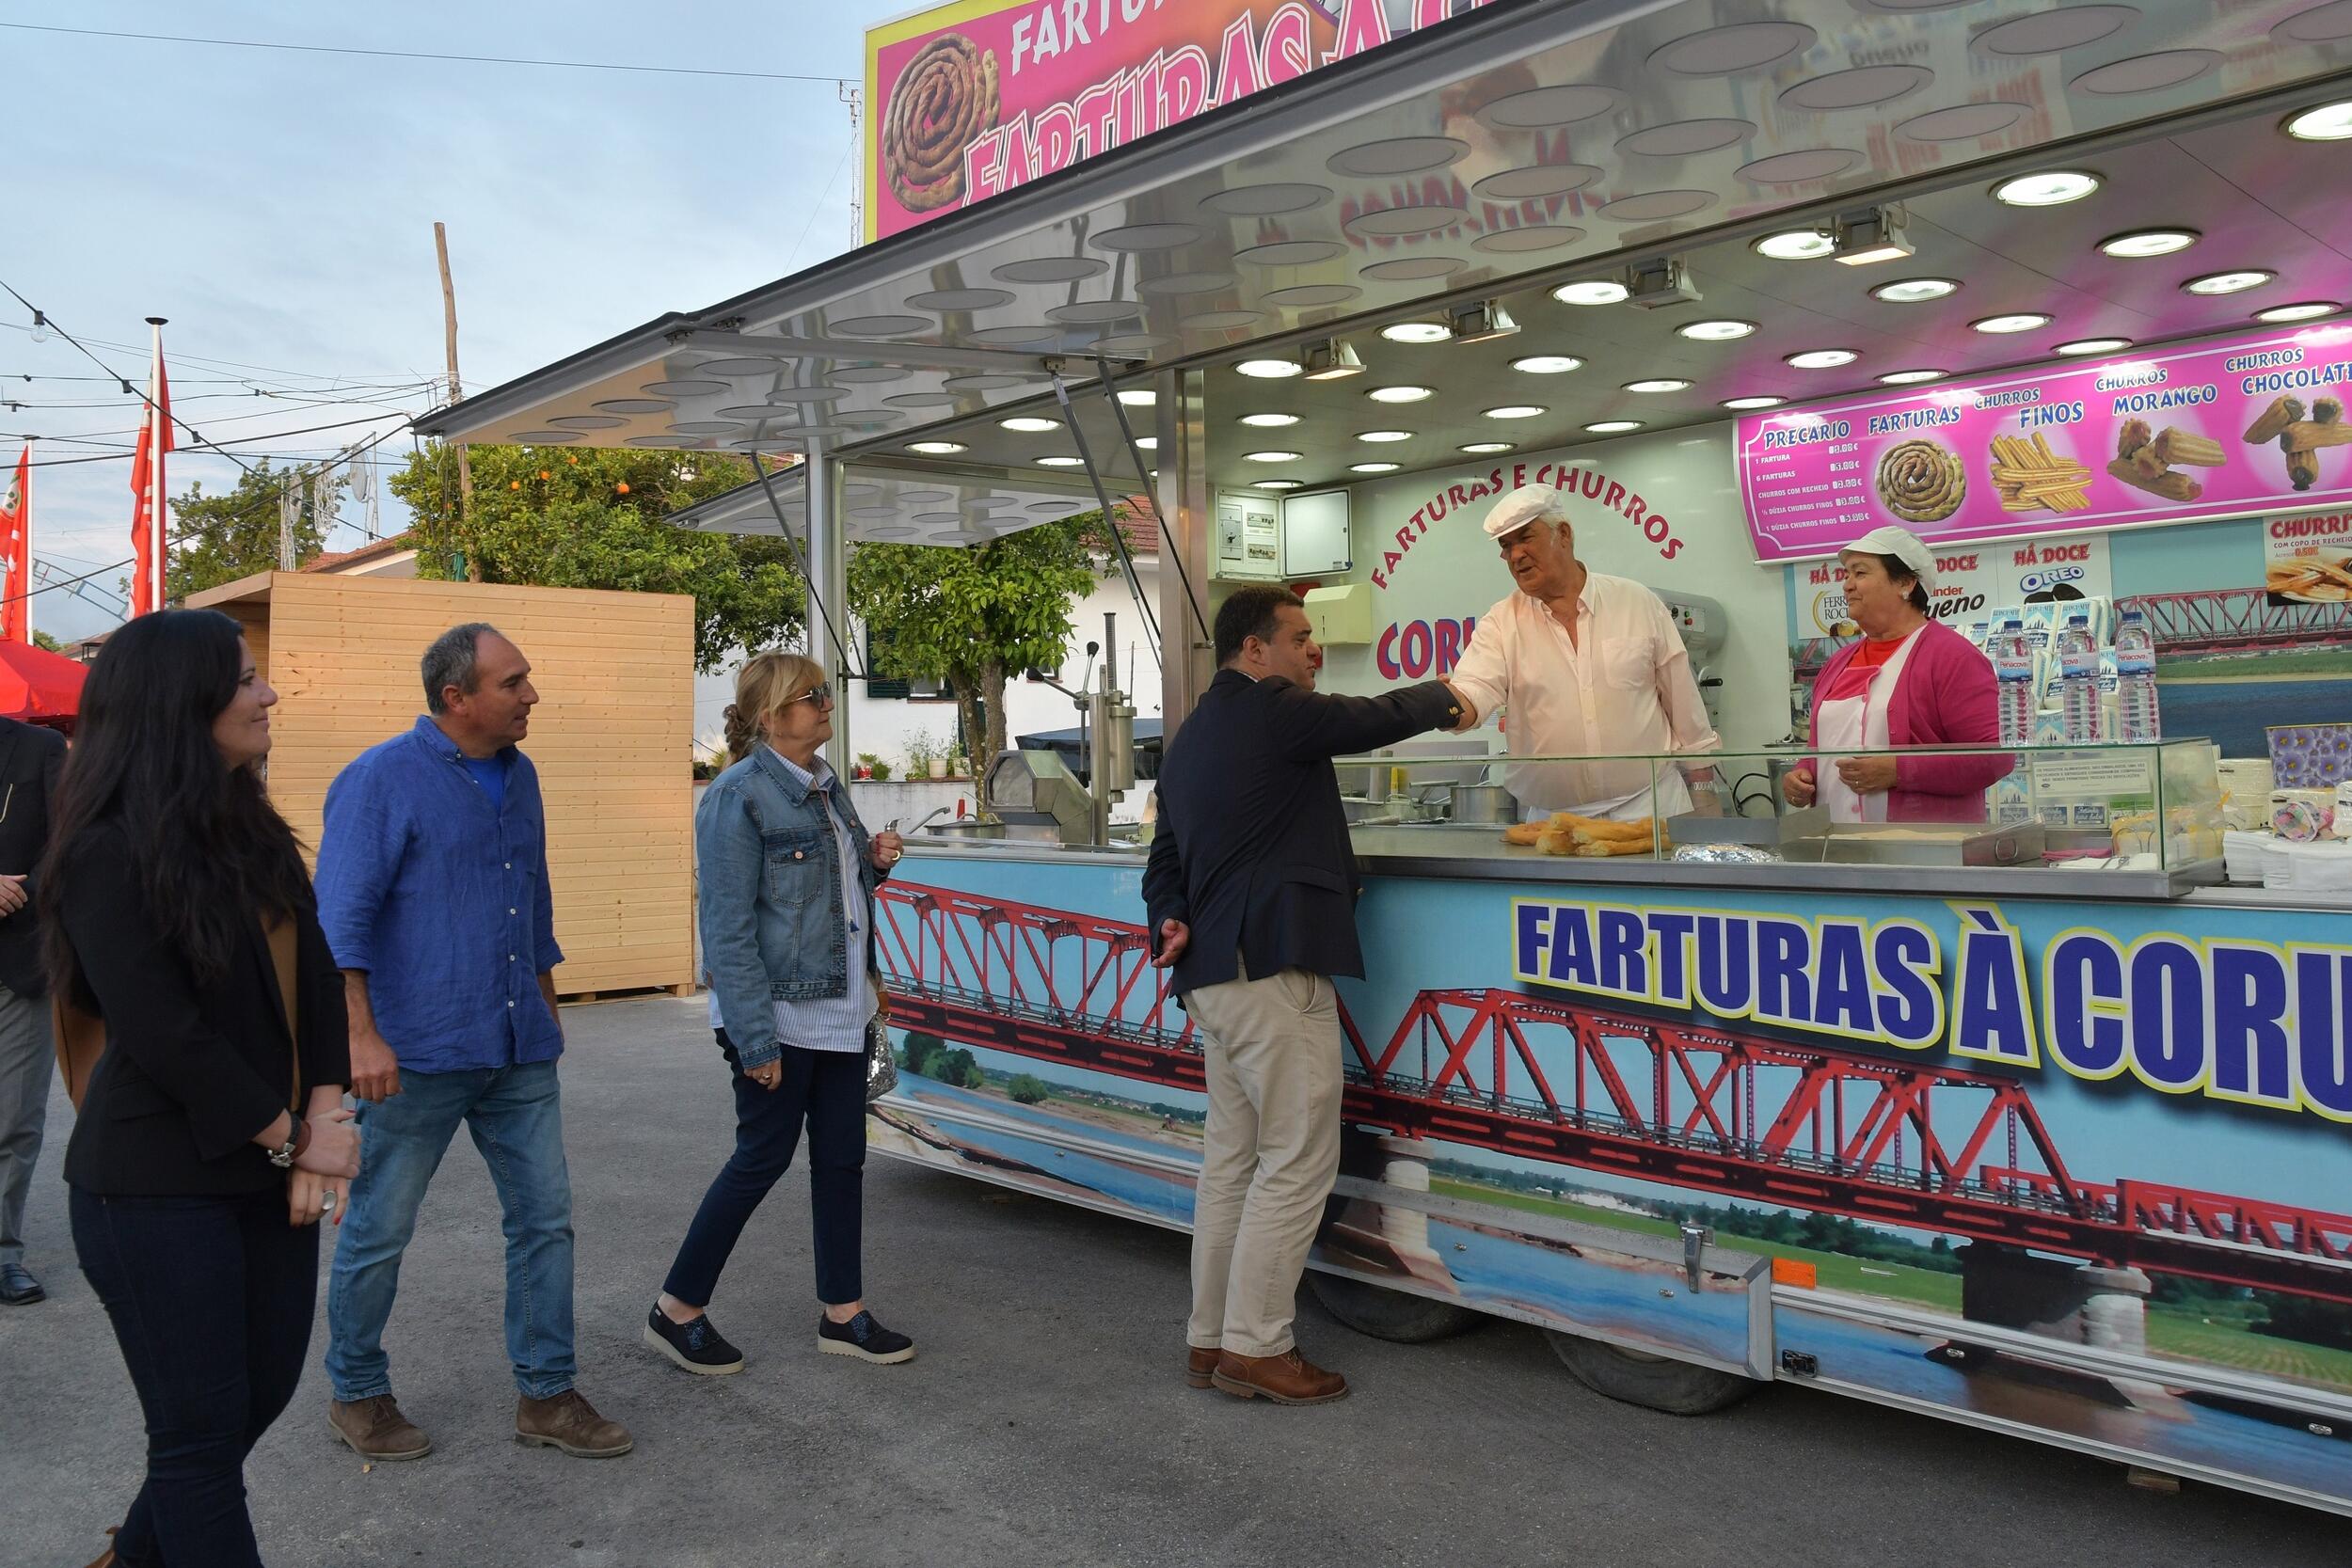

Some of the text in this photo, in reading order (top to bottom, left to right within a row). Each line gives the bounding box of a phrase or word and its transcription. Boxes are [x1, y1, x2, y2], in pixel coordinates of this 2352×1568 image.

[2224, 347, 2304, 372] CHURROS
[2095, 369, 2168, 392] CHURROS
[1974, 388, 2041, 410] CHURROS
[2113, 383, 2218, 416] MORANGO
[1868, 405, 1961, 436] FARTURAS
[2019, 402, 2083, 431] FINOS
[1764, 420, 1851, 451] PRECÁRIO
[1761, 453, 1790, 464] FARTURA
[1762, 470, 1796, 481] FARTURAS
[1758, 490, 1786, 499] CHURROS
[1802, 484, 1829, 493] RECHEIO
[1788, 503, 1814, 513] CHURROS
[1816, 500, 1834, 509] FINOS
[1371, 464, 1684, 590] FARTURAS E CHURROS
[1790, 519, 1818, 529] CHURROS
[1820, 517, 1837, 527] FINOS
[1935, 552, 1979, 573] DOCE
[2013, 541, 2091, 567] HÁ DOCE
[1810, 562, 1831, 584] HÁ
[2020, 565, 2085, 593] OREO
[1931, 586, 1964, 597] inder
[1925, 594, 1986, 619] ueno
[1511, 897, 1943, 1049] FARTURAS
[1944, 899, 2041, 1069] À
